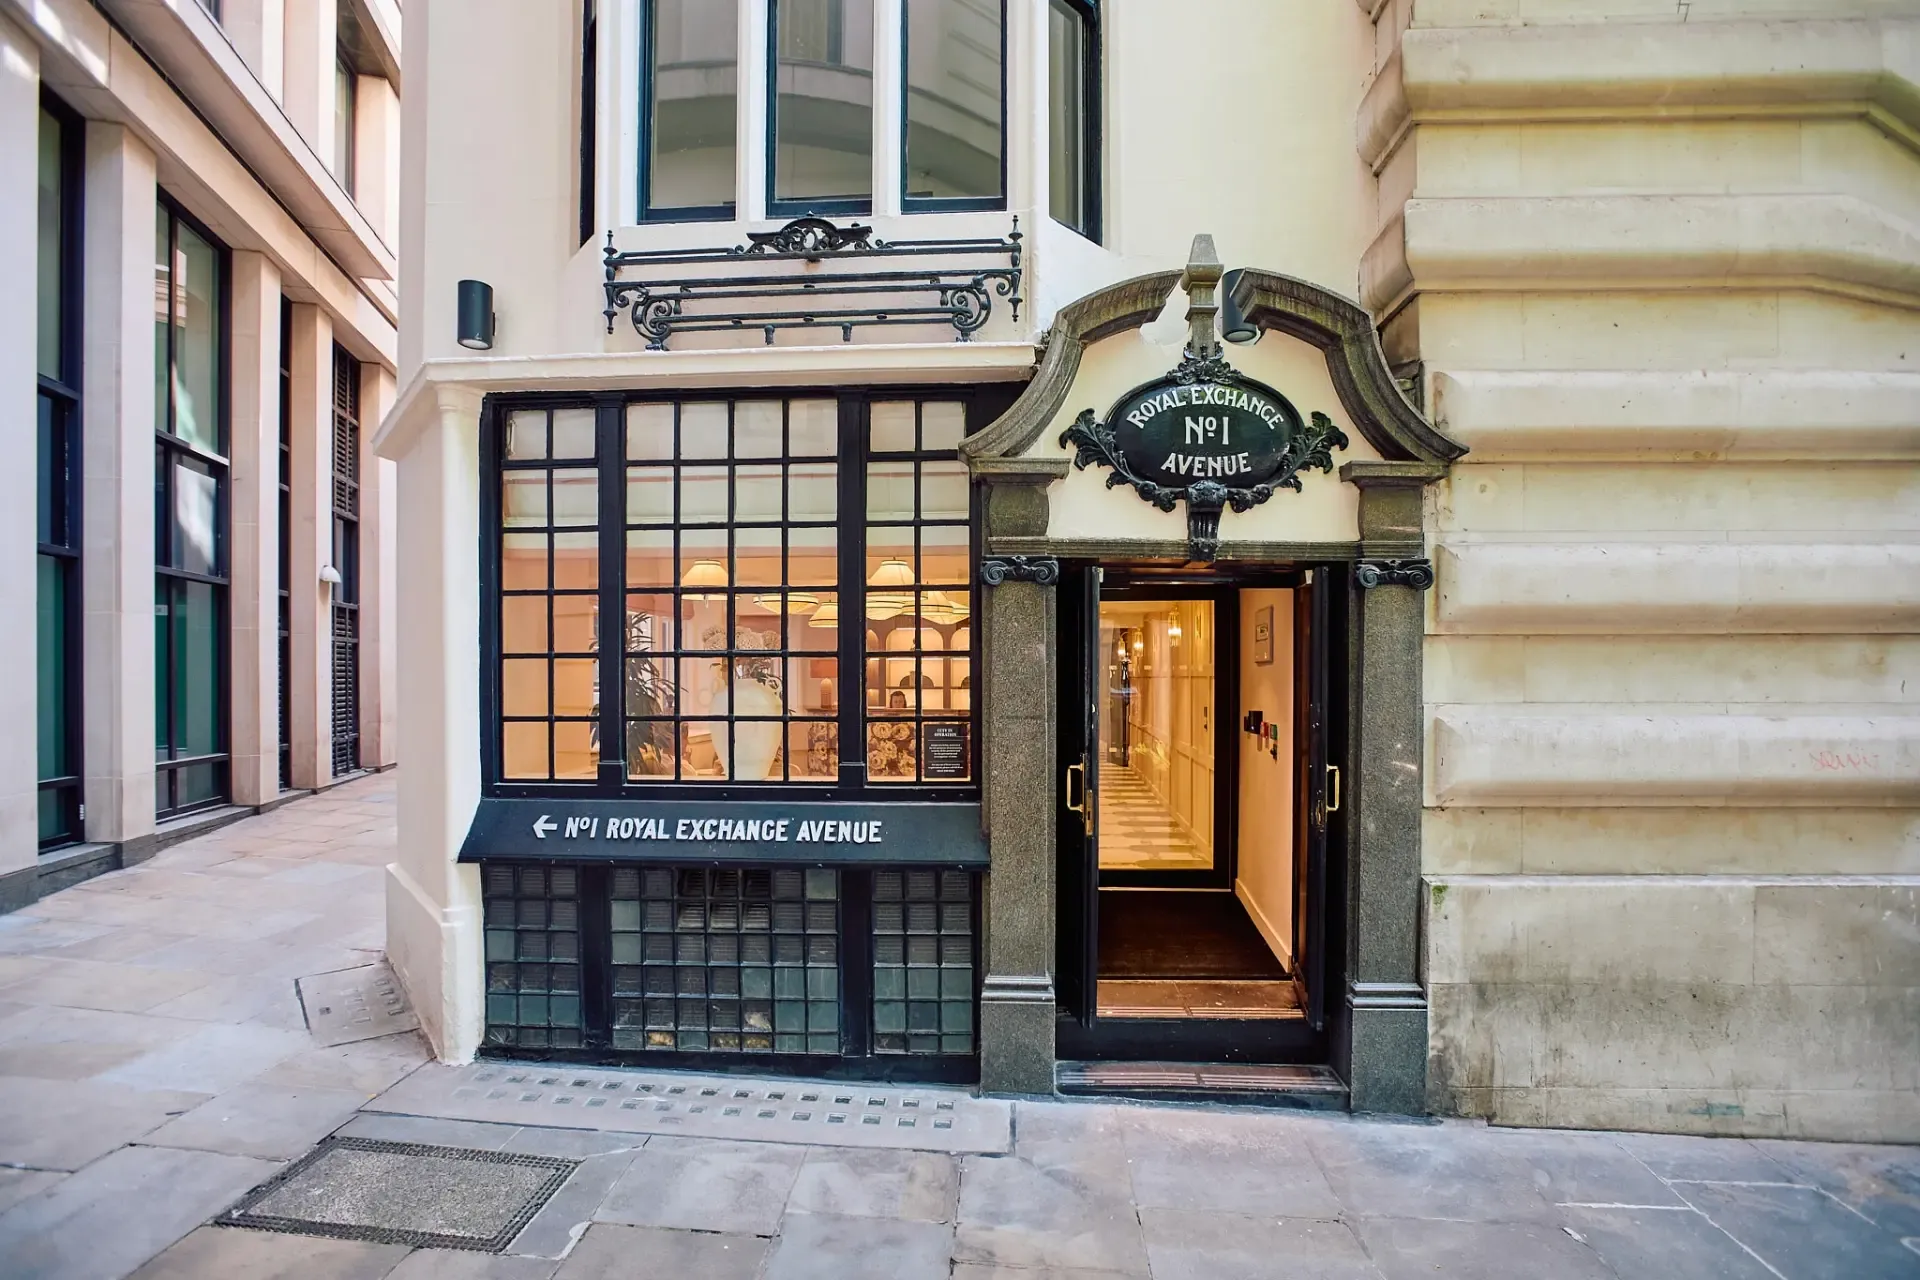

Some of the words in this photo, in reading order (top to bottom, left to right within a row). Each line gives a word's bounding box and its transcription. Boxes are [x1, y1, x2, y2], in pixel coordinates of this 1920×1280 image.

[1126, 390, 1187, 429] ROYAL
[1191, 387, 1285, 430] EXCHANGE
[1161, 452, 1252, 477] AVENUE
[606, 817, 670, 840] ROYAL
[675, 819, 788, 842] EXCHANGE
[796, 820, 882, 844] AVENUE
